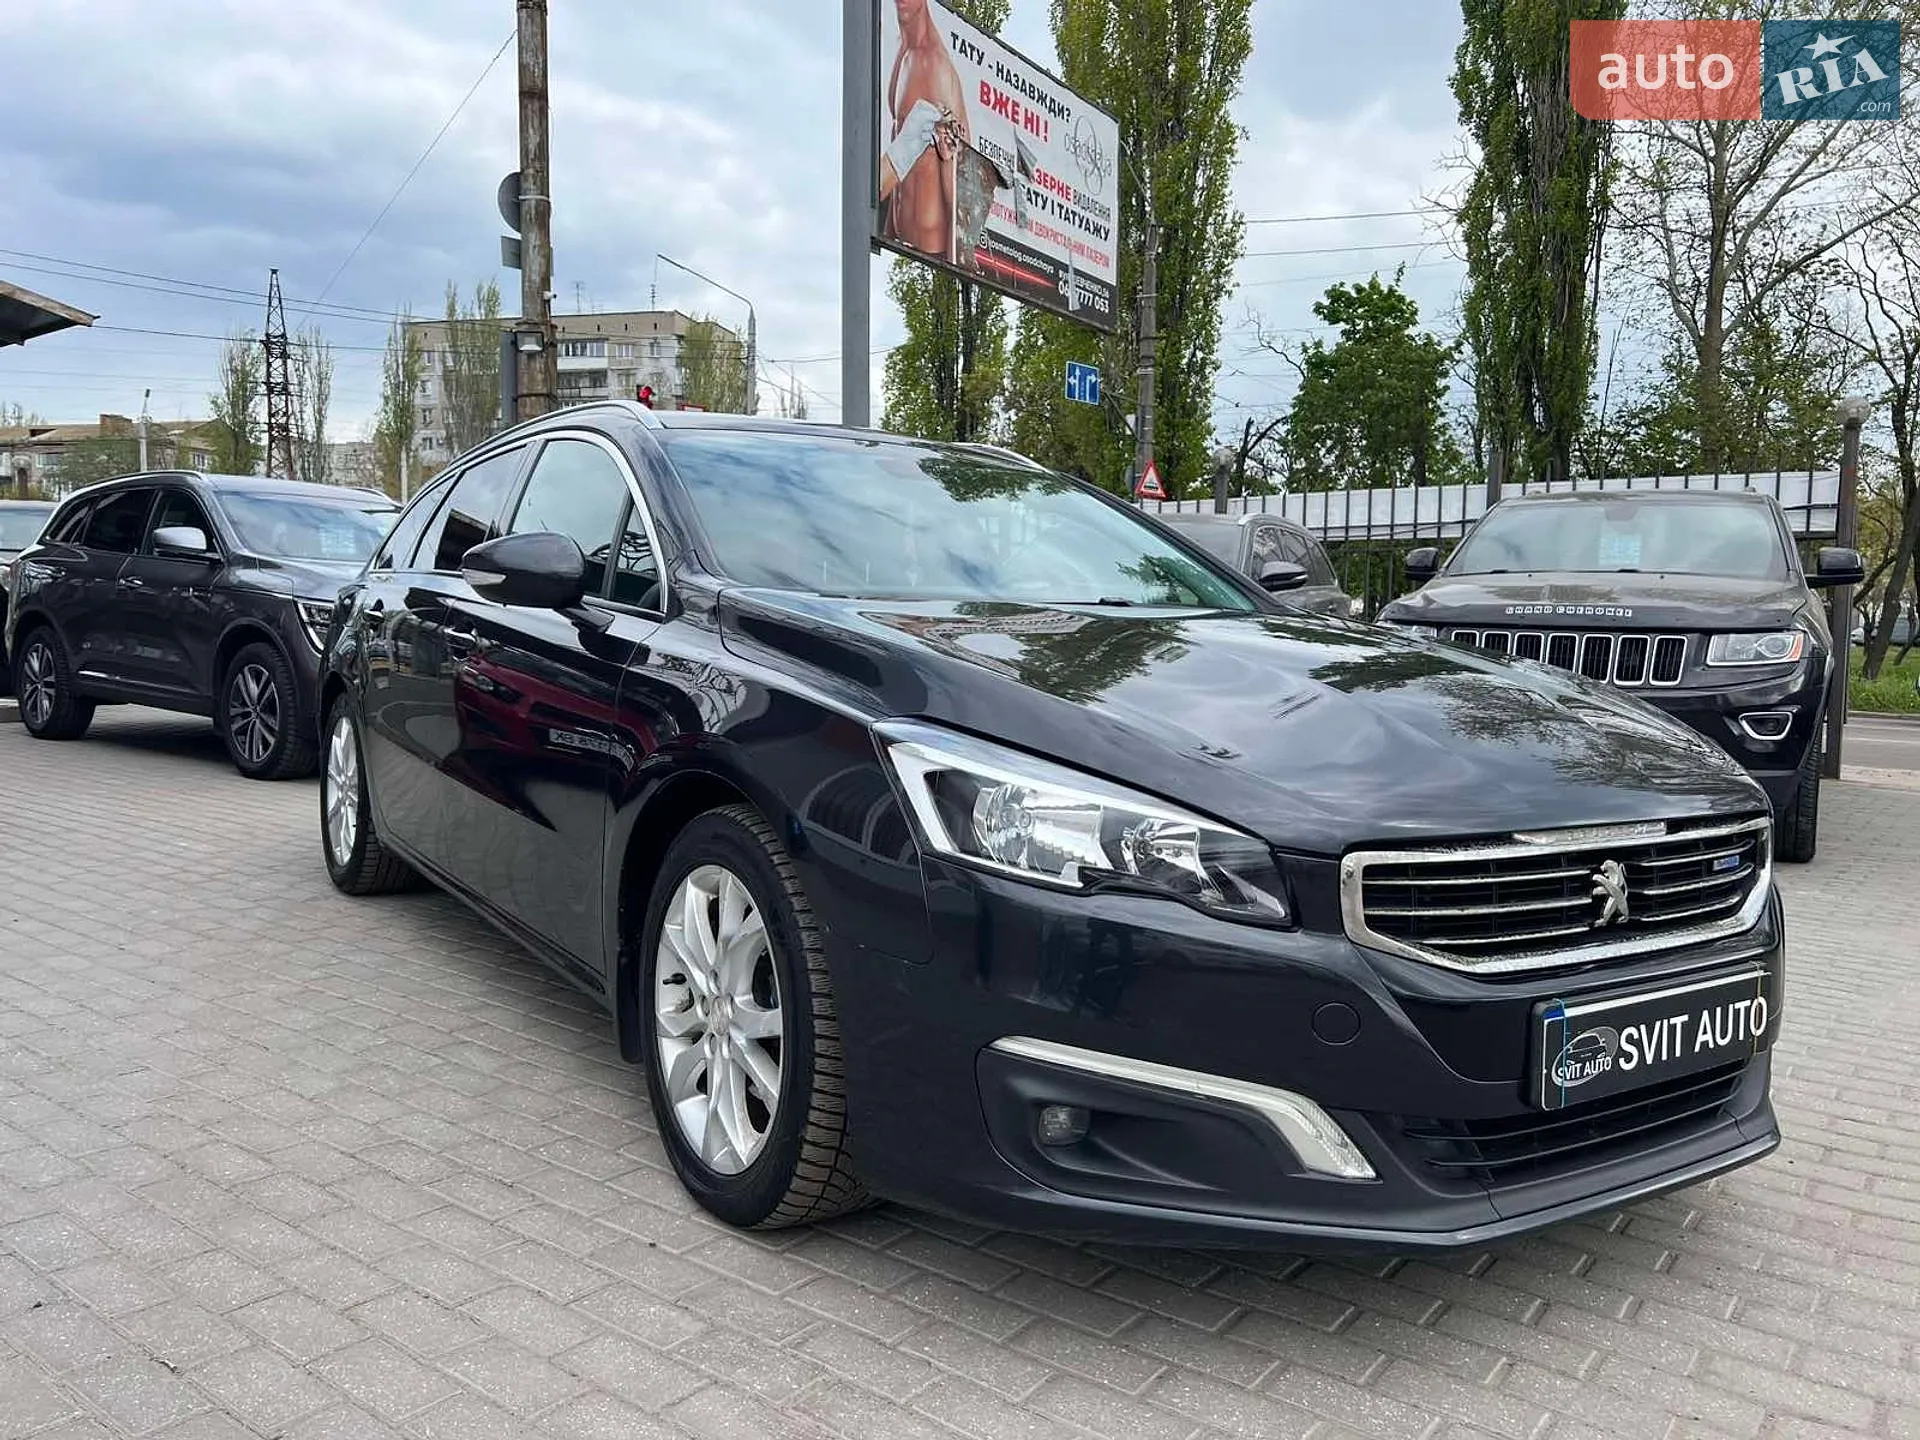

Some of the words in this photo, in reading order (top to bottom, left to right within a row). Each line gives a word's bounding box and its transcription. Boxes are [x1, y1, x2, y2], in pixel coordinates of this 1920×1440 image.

[951, 31, 985, 66] ТАТУ
[996, 60, 1071, 123] НАЗАВЖДИ?
[979, 79, 1020, 125] ВЖЕ
[1057, 201, 1110, 243] ТАТУАЖУ
[1618, 1013, 1689, 1071] SVIT
[1694, 996, 1768, 1053] AUTO
[1556, 1063, 1583, 1083] SVIT
[1583, 1056, 1612, 1077] AUTO
